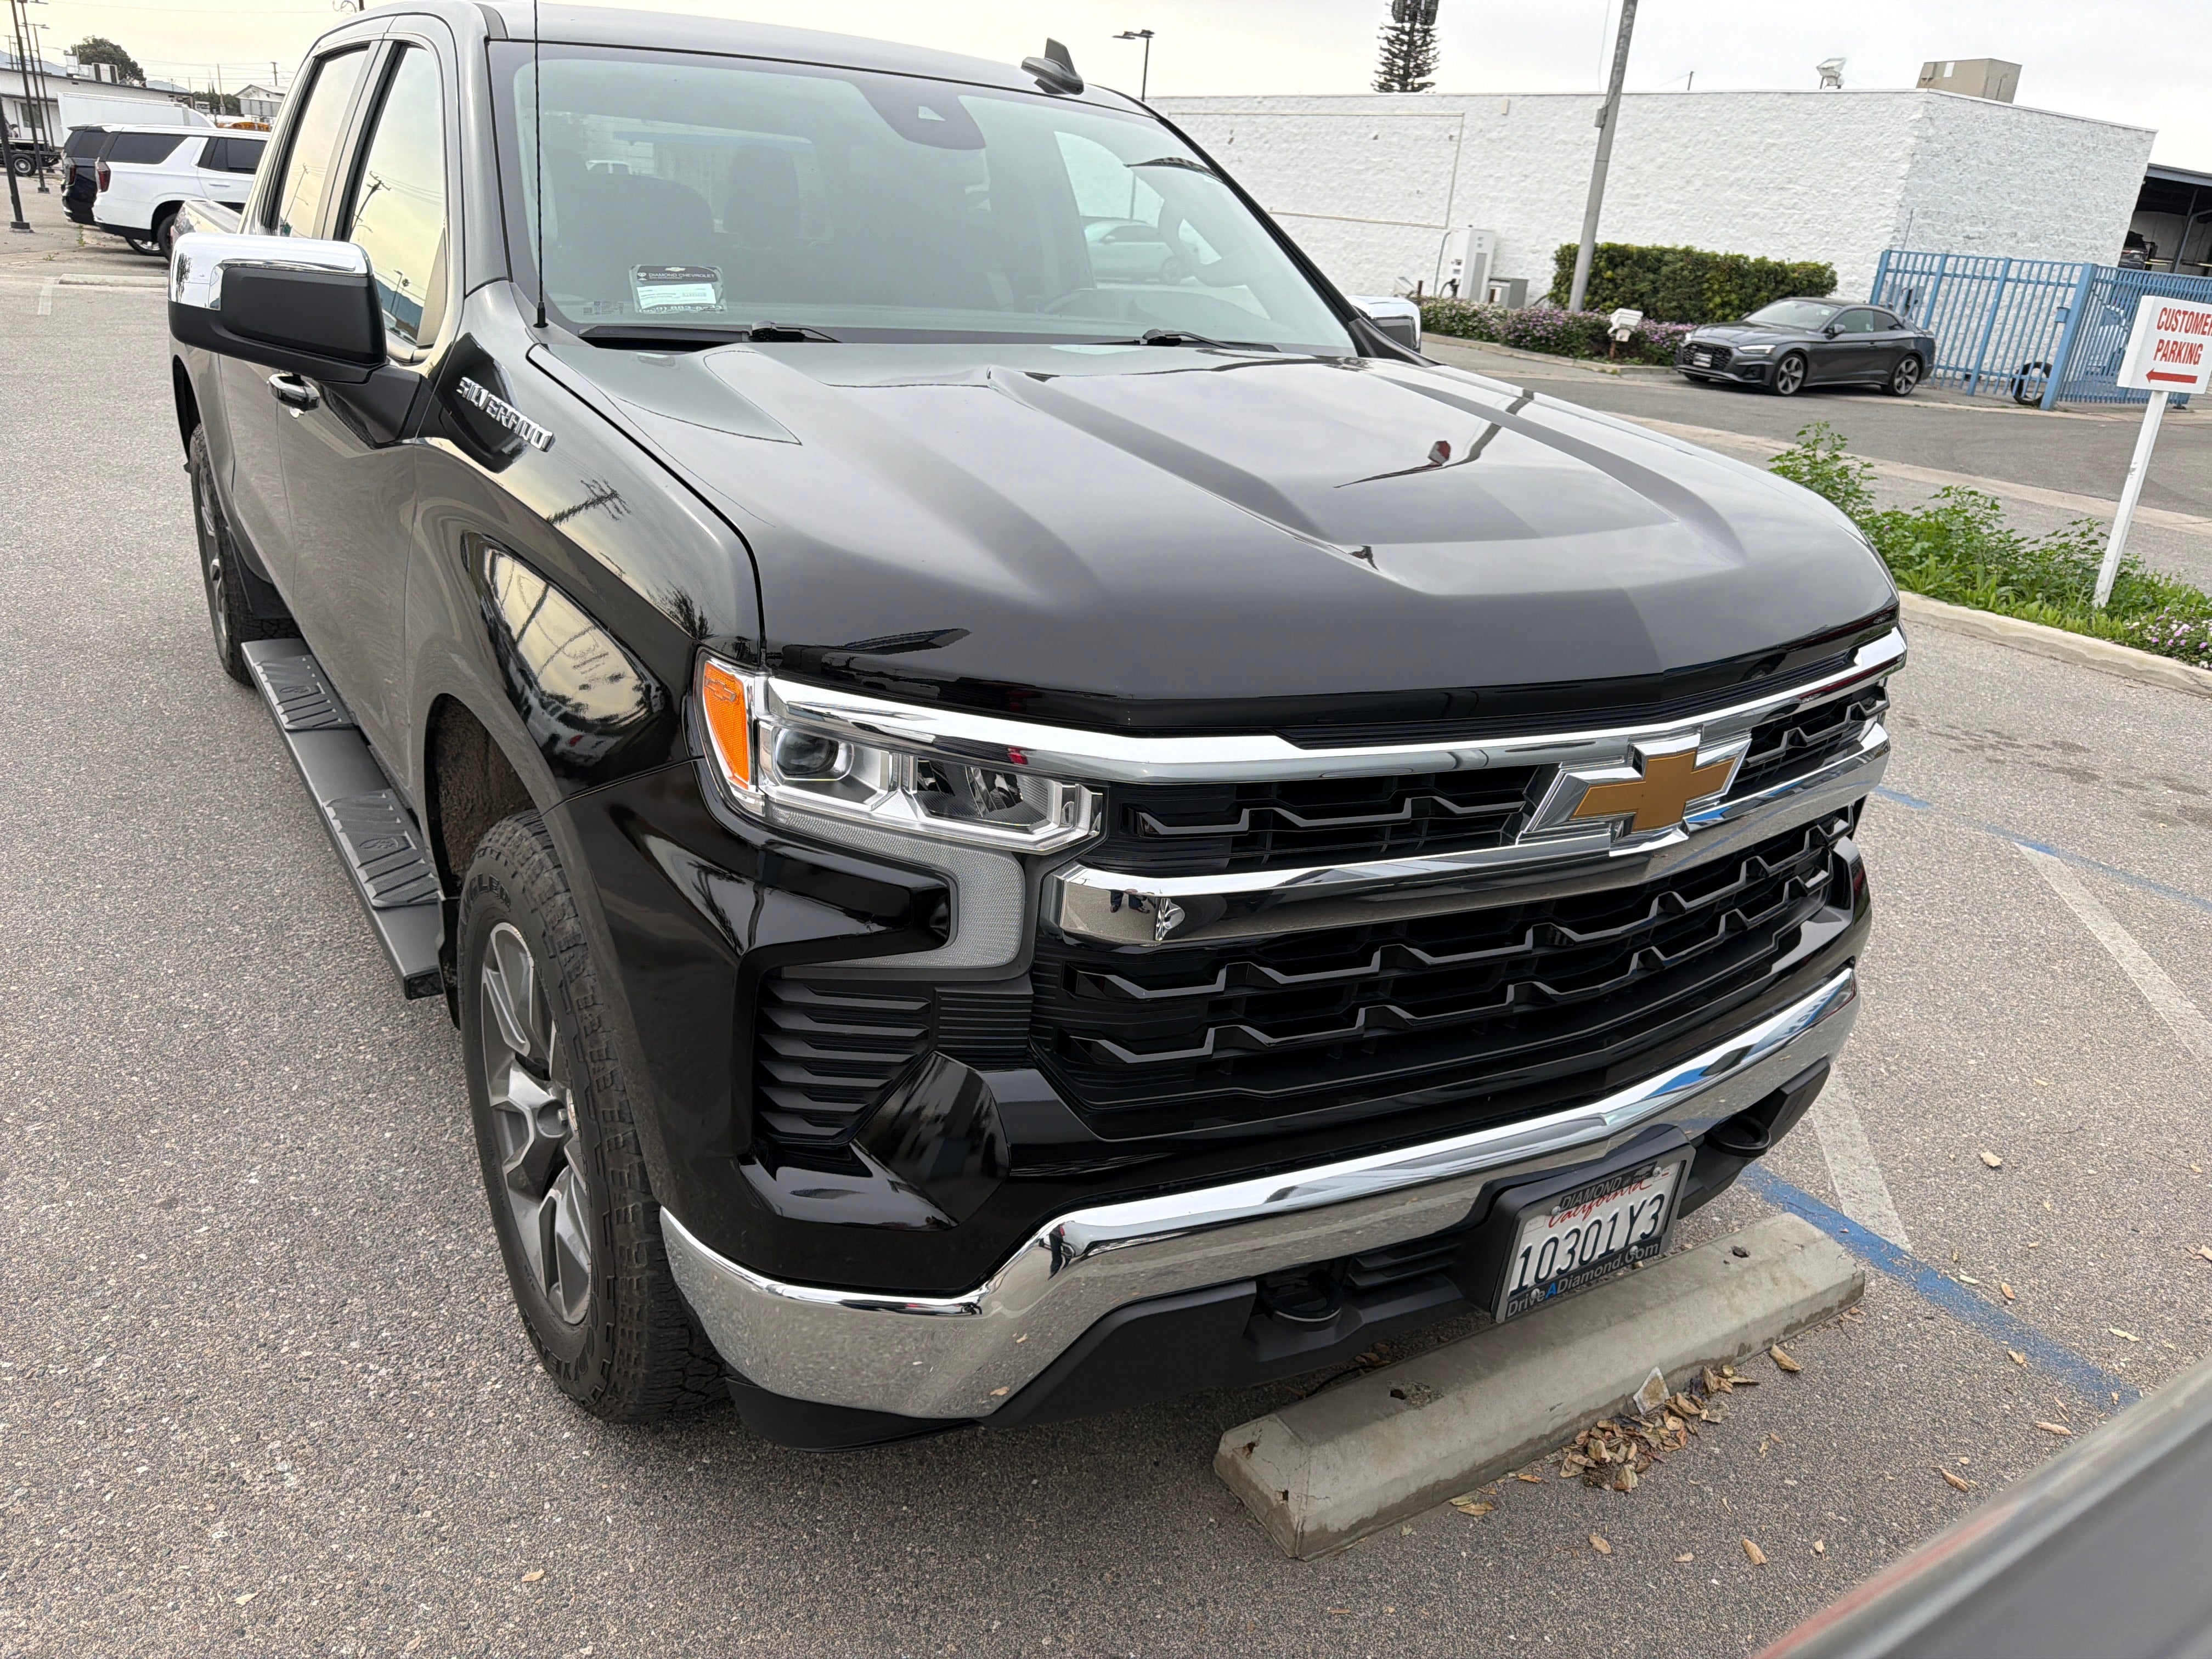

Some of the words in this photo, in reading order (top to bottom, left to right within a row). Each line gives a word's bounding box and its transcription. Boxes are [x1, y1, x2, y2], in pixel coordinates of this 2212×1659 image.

[2153, 339, 2203, 365] PARKING
[456, 376, 554, 450] SILVERADO
[1561, 1177, 1622, 1210] DIAMOND
[1507, 1243, 1658, 1317] DriveADiamond.Com
[1509, 1193, 1664, 1297] 10301Y3
